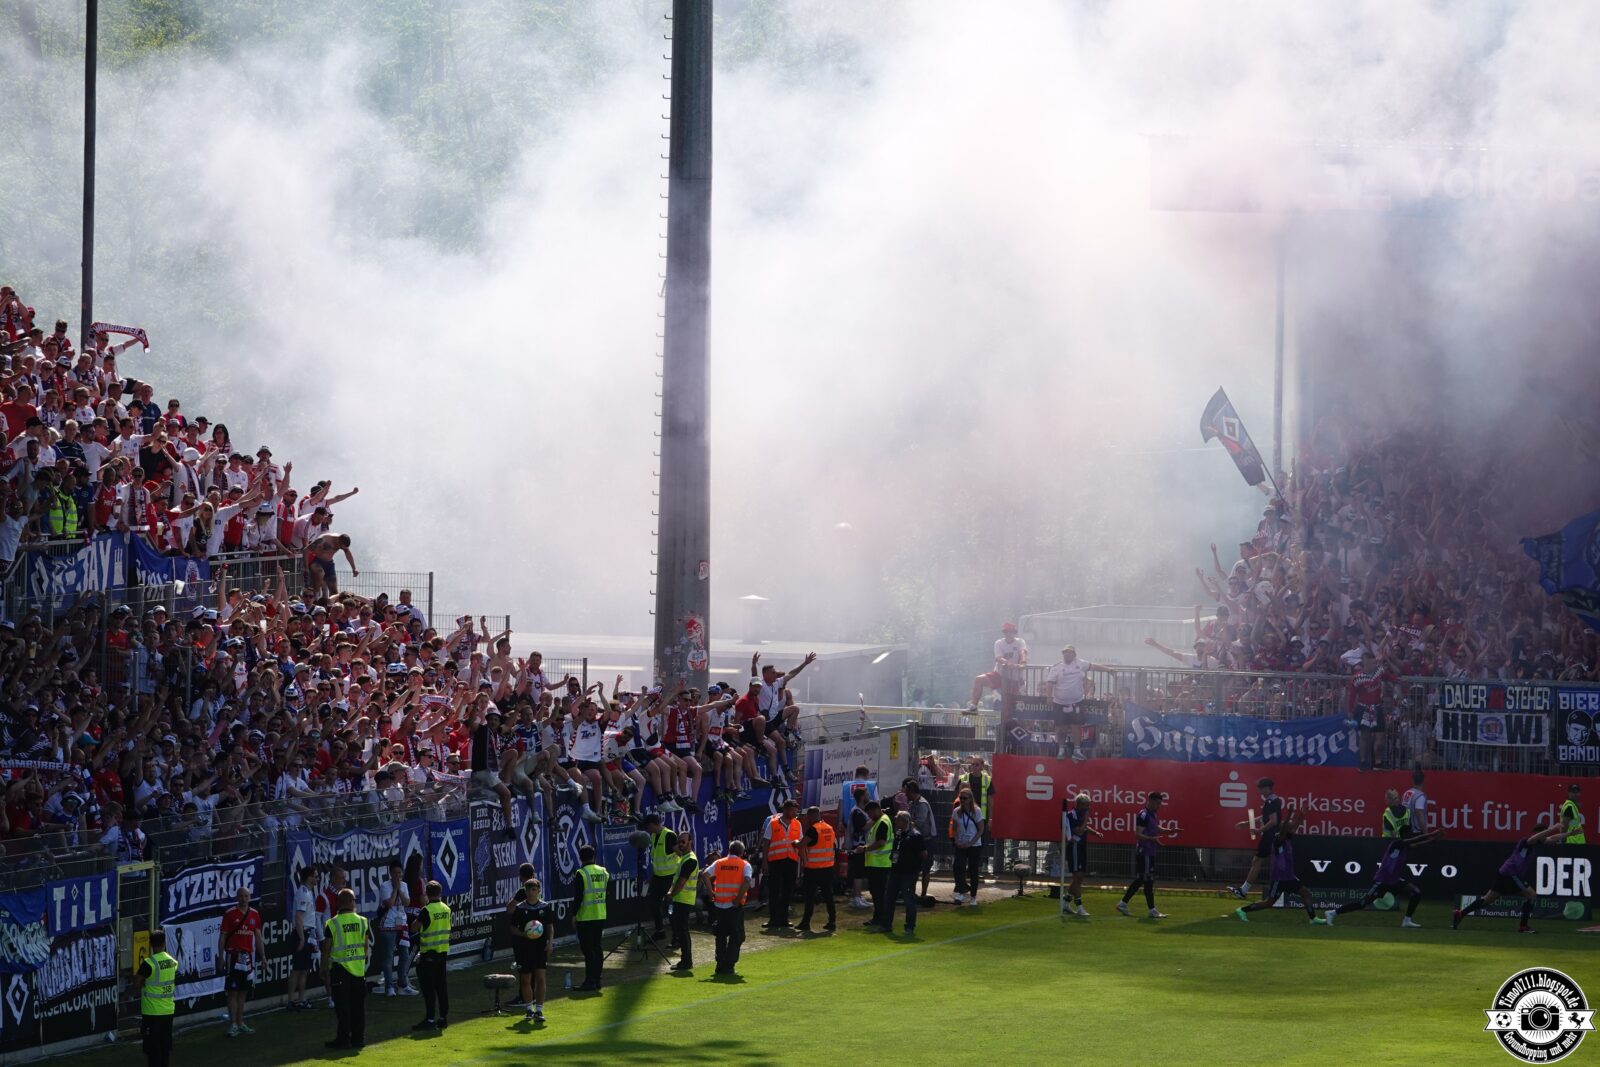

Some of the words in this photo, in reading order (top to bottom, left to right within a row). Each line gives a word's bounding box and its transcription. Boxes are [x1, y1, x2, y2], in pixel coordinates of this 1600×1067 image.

[1445, 685, 1487, 709] DAUER
[1506, 686, 1551, 710] STEHER
[1127, 716, 1361, 767] Hafensänger
[823, 767, 854, 787] Biermann
[1066, 783, 1170, 812] Sarkase
[1481, 800, 1528, 832] für
[312, 829, 400, 864] HSV-FREUNDE
[493, 840, 517, 869] STERN
[1310, 860, 1459, 879] VOVO
[1536, 856, 1592, 897] DER
[168, 864, 256, 913] ITZEHOE
